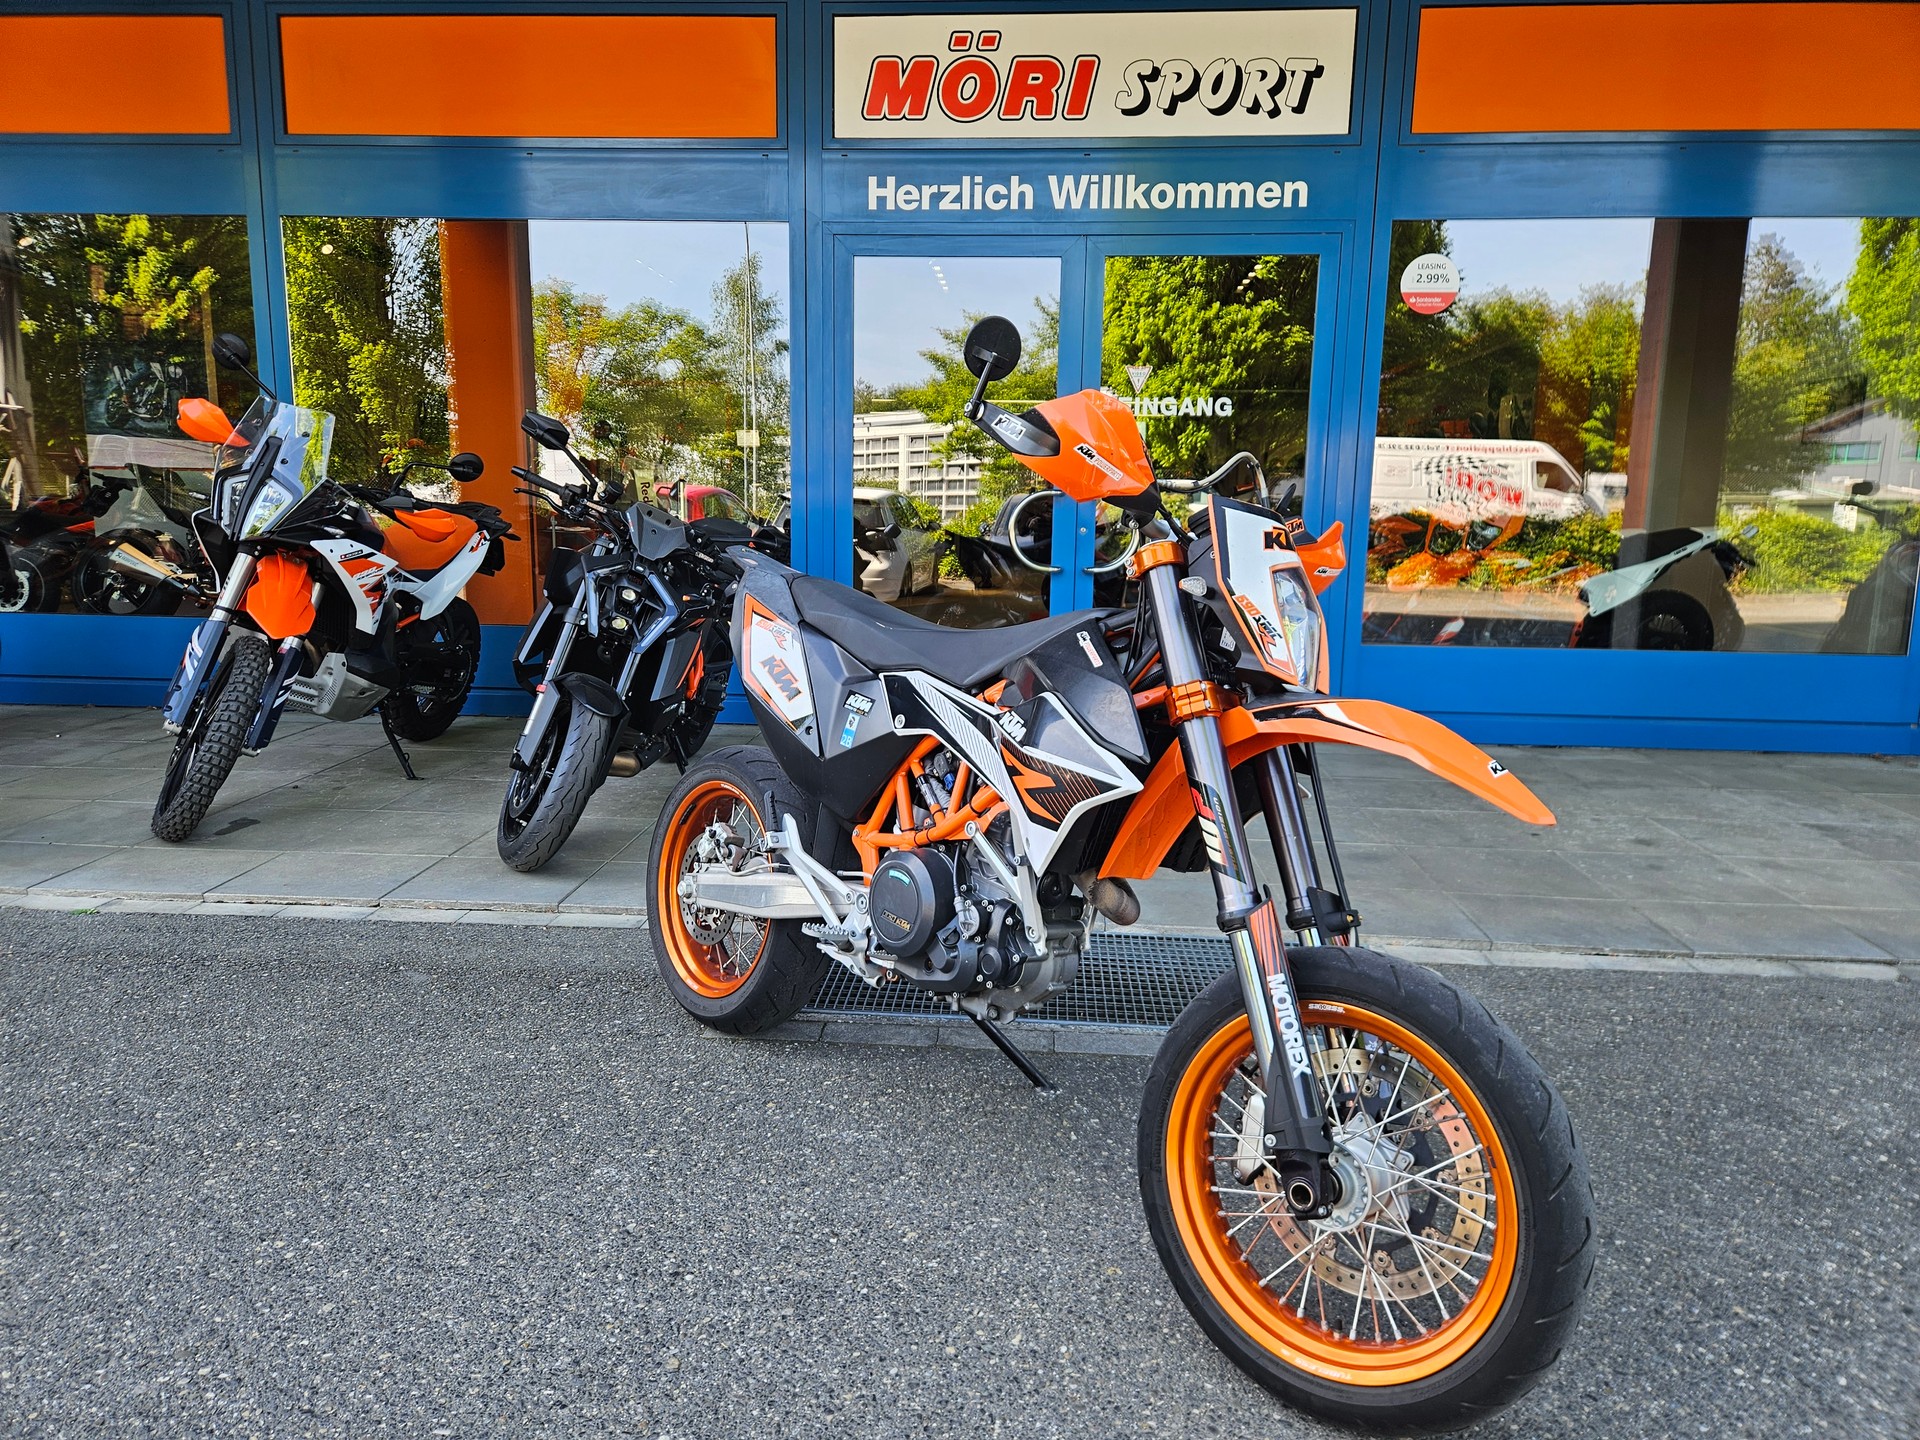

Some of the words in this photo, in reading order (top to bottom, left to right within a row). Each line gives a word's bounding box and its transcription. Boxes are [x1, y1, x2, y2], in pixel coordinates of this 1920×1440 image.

[861, 30, 1101, 124] MÖRI
[1115, 57, 1325, 119] SPORT
[868, 175, 1034, 211] Herzlich
[1048, 174, 1309, 210] Willkommen
[1416, 273, 1450, 284] 2.99%
[1417, 262, 1448, 270] LEASING
[1076, 445, 1095, 461] KTM
[761, 656, 802, 701] KTM
[845, 693, 873, 713] KTM
[999, 711, 1027, 742] KTM
[1267, 973, 1312, 1079] MOTOREX
